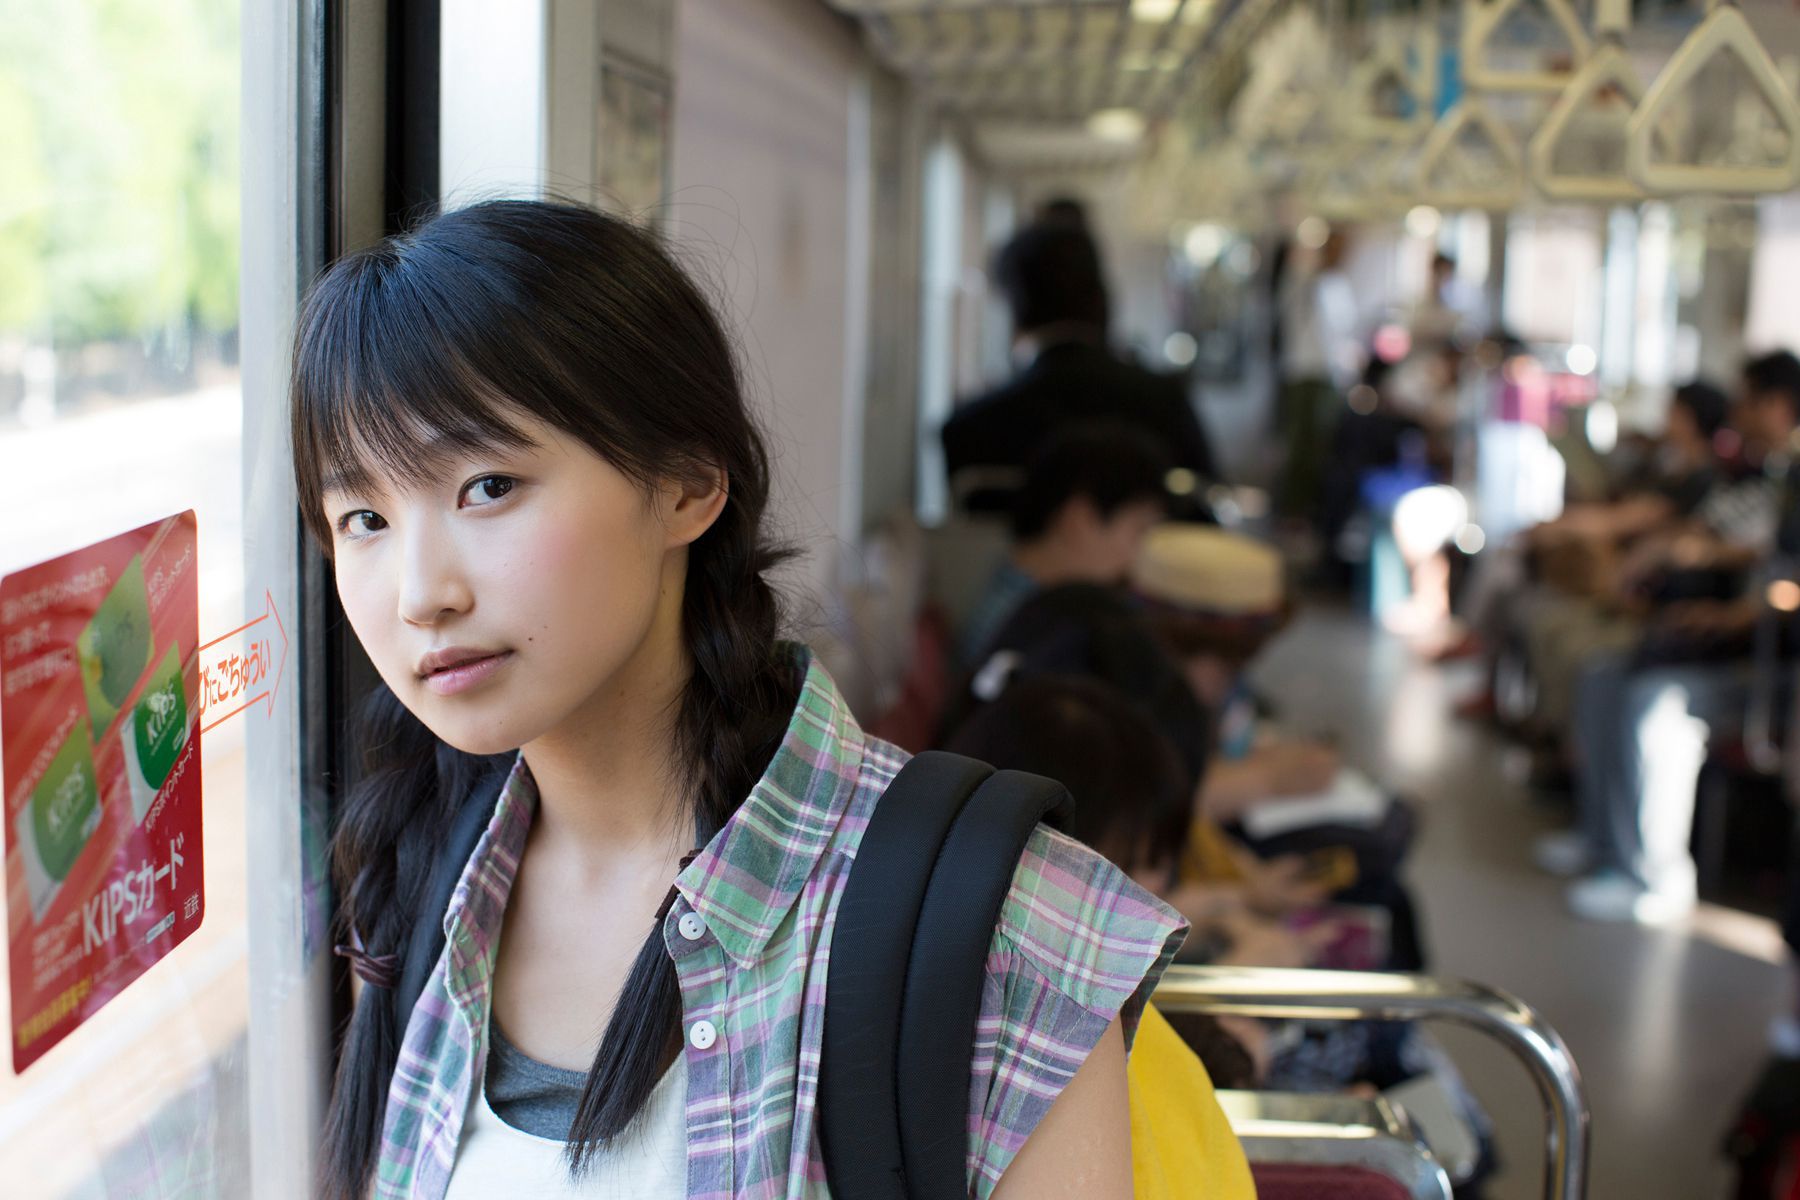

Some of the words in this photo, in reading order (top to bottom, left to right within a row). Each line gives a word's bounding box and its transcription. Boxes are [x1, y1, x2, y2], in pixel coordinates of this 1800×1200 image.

[83, 832, 184, 956] KIPSカード
[184, 893, 199, 920] 近鉄
